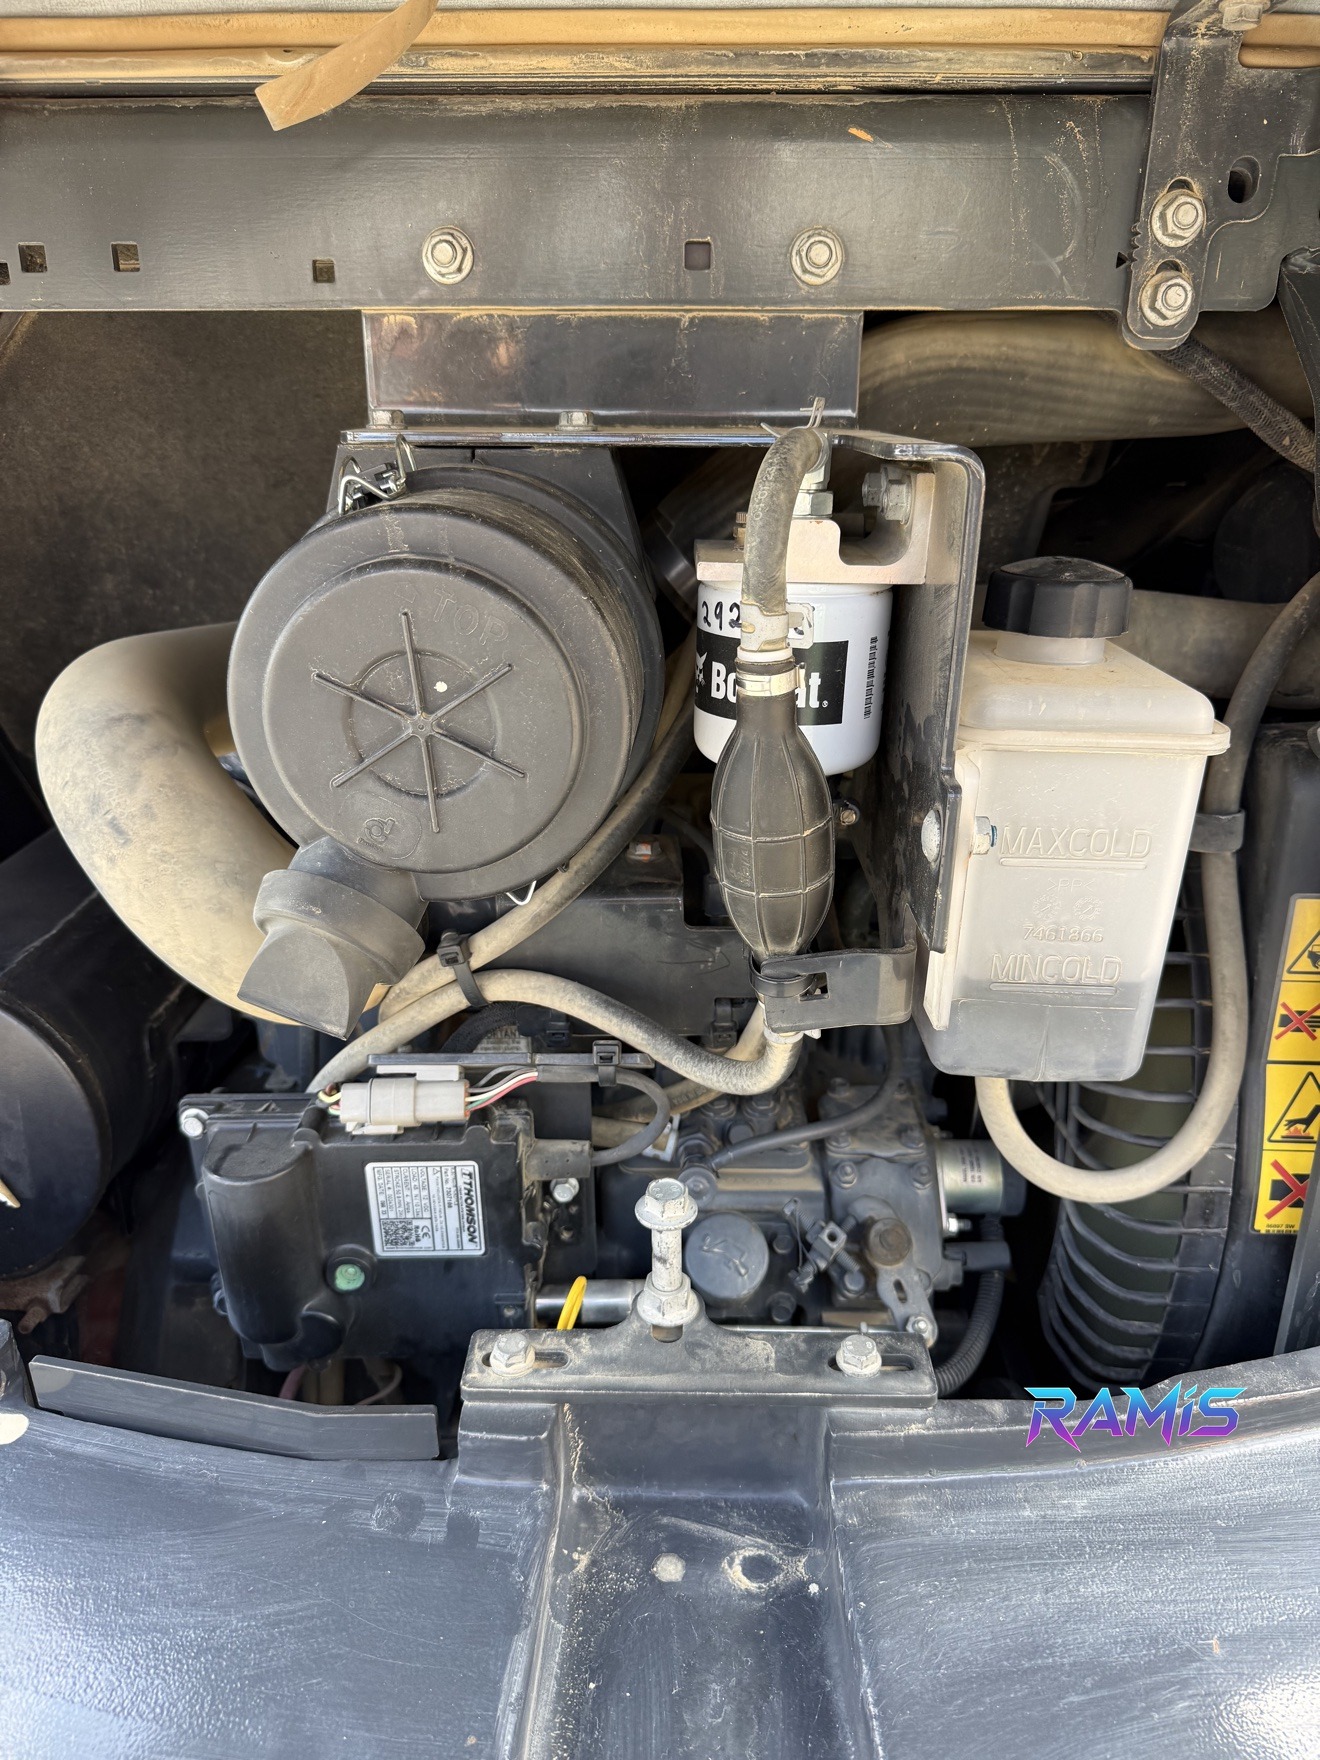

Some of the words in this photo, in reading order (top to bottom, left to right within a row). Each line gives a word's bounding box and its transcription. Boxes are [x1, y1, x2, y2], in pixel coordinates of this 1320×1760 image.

[433, 587, 508, 645] TOP
[1000, 825, 1153, 858] MAXCOLD
[1022, 925, 1104, 943] 7461866
[990, 953, 1123, 985] MINCOLD
